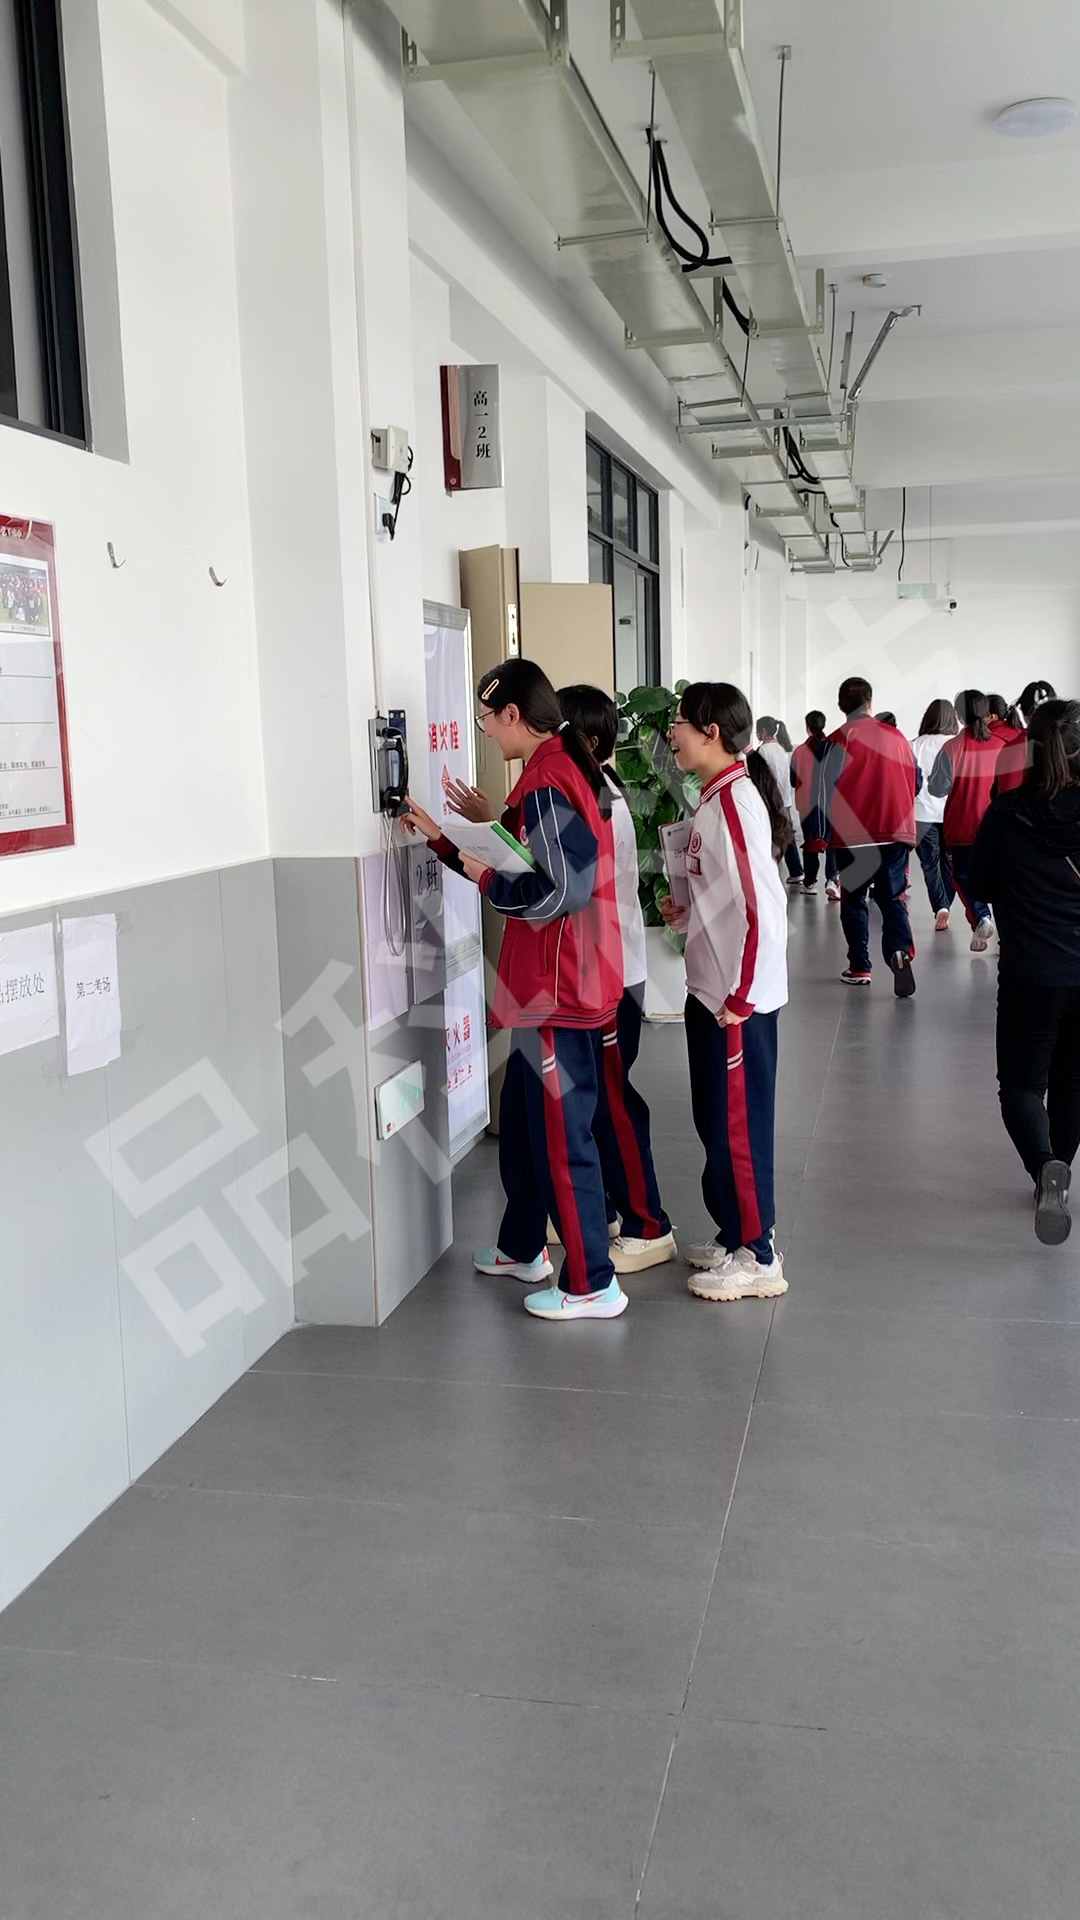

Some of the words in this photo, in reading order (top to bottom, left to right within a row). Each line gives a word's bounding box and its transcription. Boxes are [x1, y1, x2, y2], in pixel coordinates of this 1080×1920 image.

[474, 390, 491, 458] 高一2班
[429, 721, 459, 752] 消火栓
[76, 977, 111, 999] 第二考场
